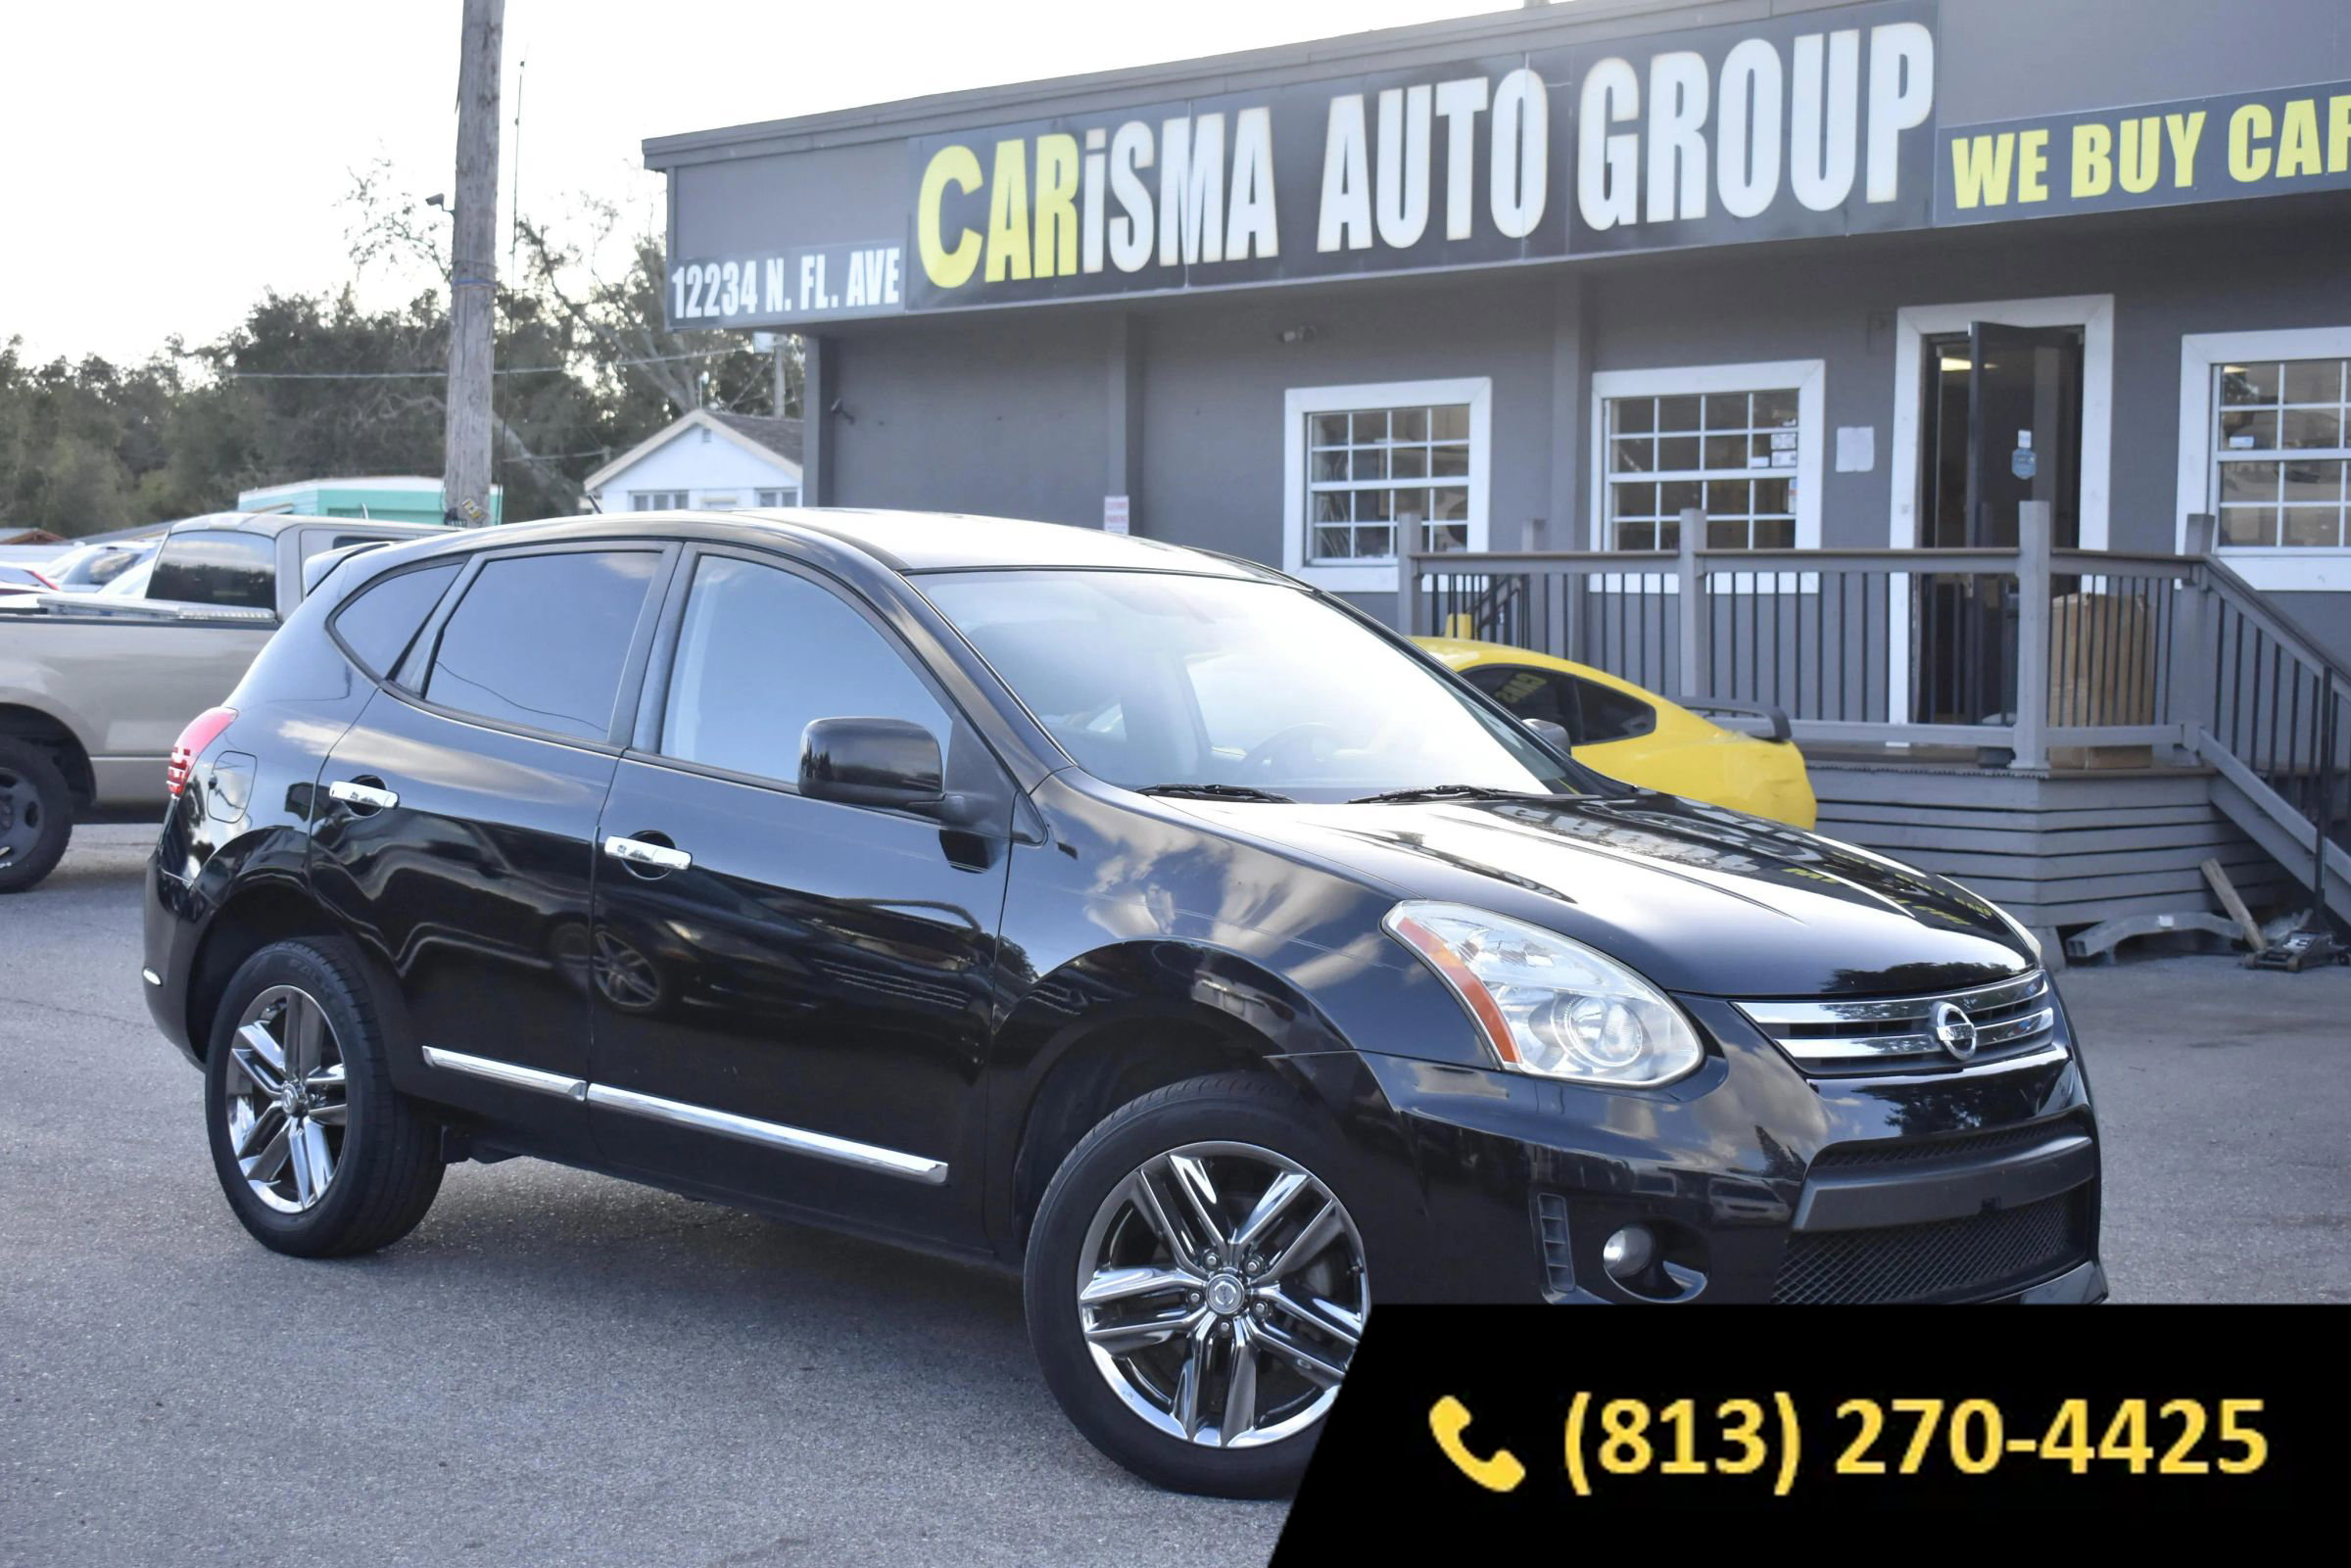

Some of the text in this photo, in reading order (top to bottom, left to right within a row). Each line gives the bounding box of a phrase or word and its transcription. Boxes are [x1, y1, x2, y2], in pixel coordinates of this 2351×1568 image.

[918, 22, 1934, 288] CARiSMA AUTO GROUP
[1951, 129, 2048, 209] WE
[2071, 111, 2206, 198] BUY
[672, 248, 900, 319] 12234 N. FL. AVE
